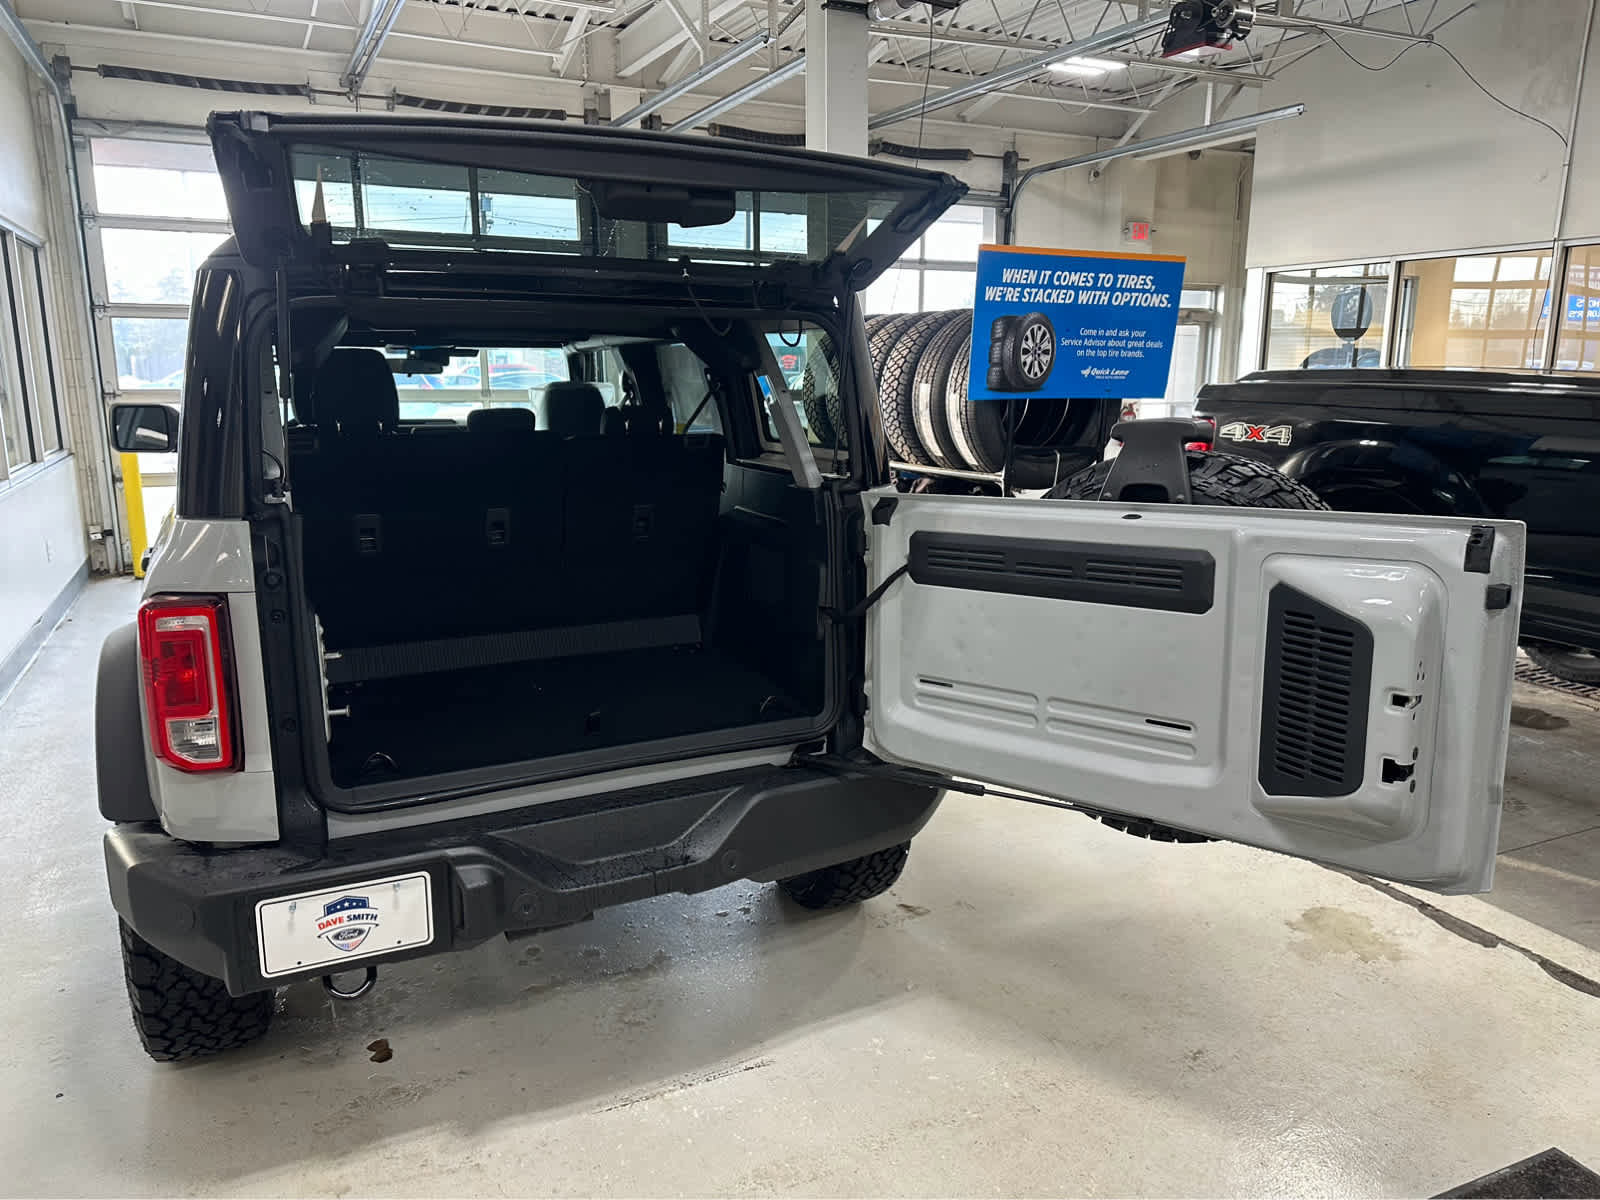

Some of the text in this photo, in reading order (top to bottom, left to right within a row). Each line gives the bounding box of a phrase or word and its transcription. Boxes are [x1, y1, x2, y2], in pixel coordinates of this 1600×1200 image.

[1002, 268, 1156, 292] WHEN IT COMES TO TIRES,
[984, 286, 1172, 309] WE'RE STACKED WITH OPTIONS.
[1079, 328, 1146, 339] Come in and ask your
[1061, 338, 1163, 349] Service Advisor about great deals
[1085, 349, 1096, 357] the
[1096, 349, 1107, 359] top
[1108, 349, 1119, 358] tire
[1120, 349, 1144, 358] brands.
[1091, 368, 1109, 376] Quick
[317, 913, 378, 931] DAVE SMITH
